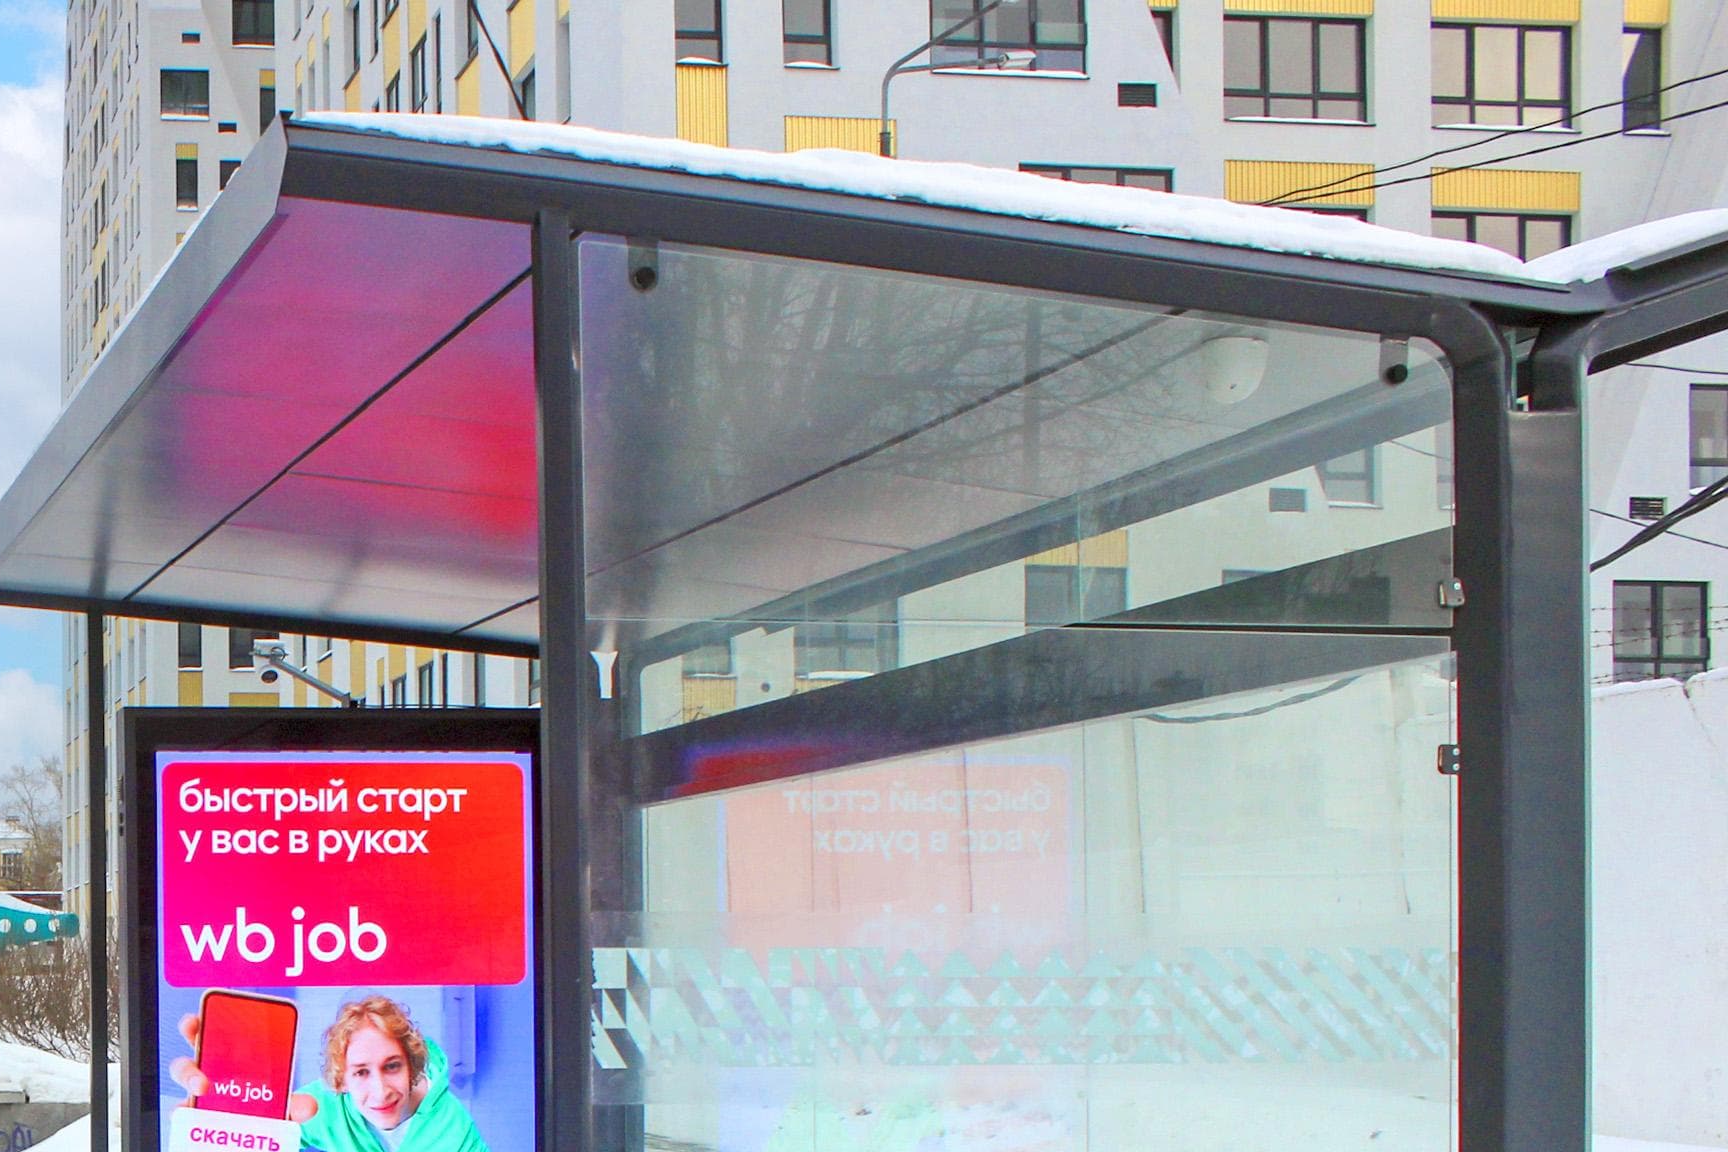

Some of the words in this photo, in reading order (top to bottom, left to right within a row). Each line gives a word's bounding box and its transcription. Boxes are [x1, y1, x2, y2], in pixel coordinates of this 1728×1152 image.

[179, 778, 348, 821] быстрый
[357, 787, 468, 821] старт
[179, 829, 203, 863] у
[211, 829, 280, 855] вас
[288, 829, 309, 854] в
[318, 829, 429, 863] руках
[181, 906, 275, 963] wb
[285, 906, 387, 977] job
[214, 1078, 242, 1097] wb
[242, 1082, 273, 1103] job
[189, 1124, 281, 1152] скачать
